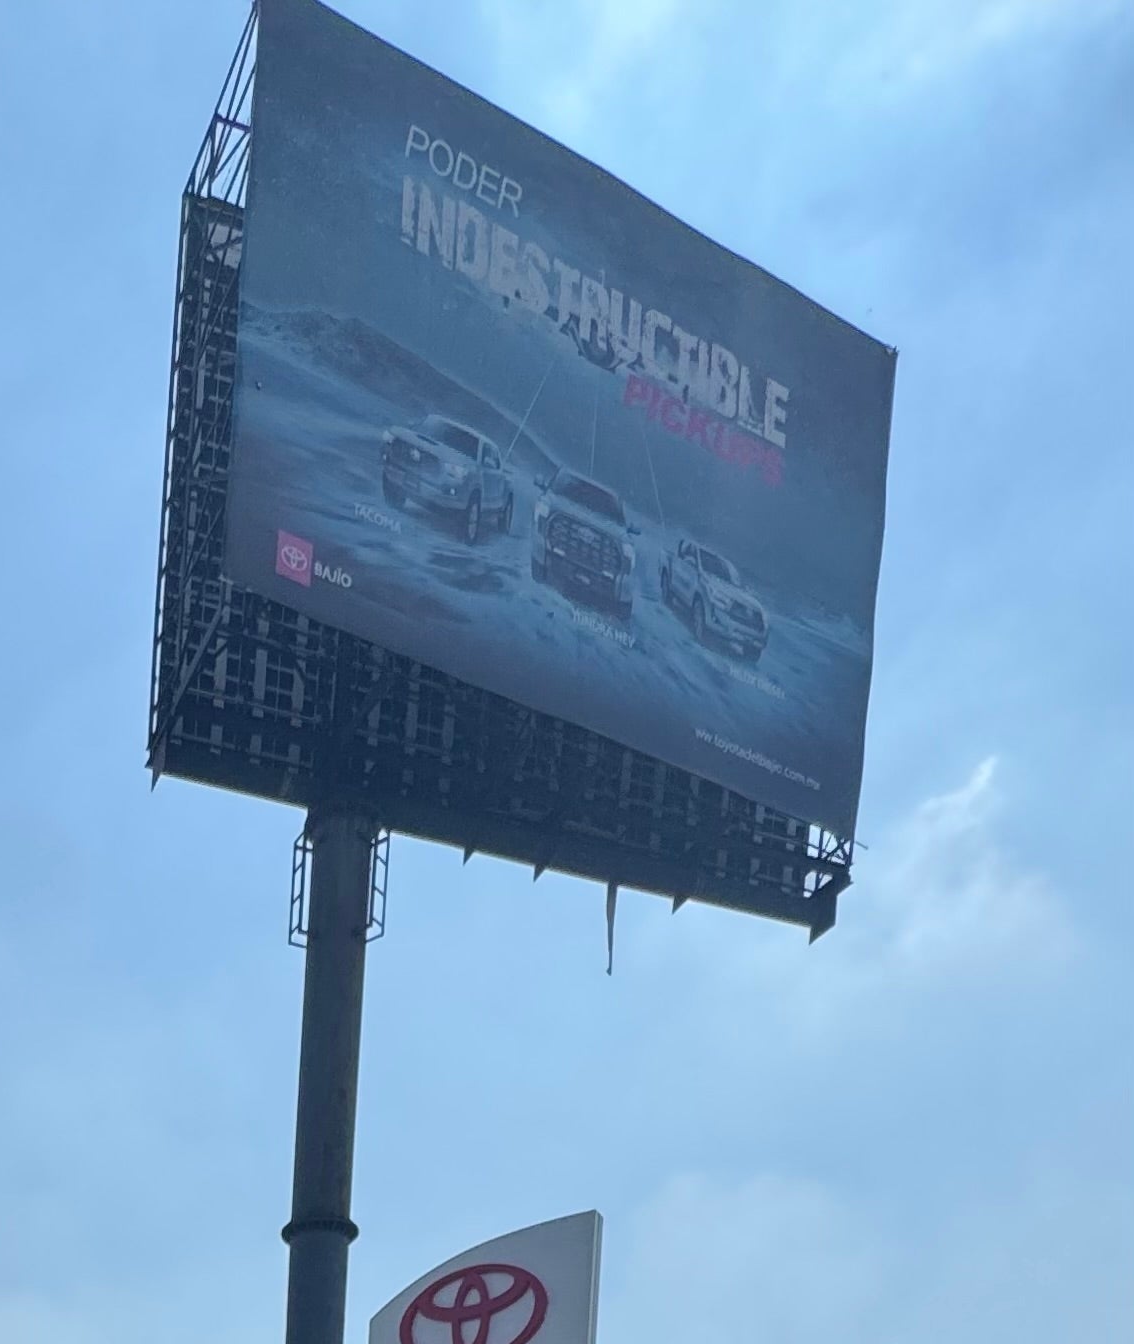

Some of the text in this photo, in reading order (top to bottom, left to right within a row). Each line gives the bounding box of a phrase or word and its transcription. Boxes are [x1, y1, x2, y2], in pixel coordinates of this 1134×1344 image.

[404, 124, 523, 218] PODER
[400, 175, 791, 449] INDESTRUCTIBLE
[353, 502, 403, 534] TACOMA
